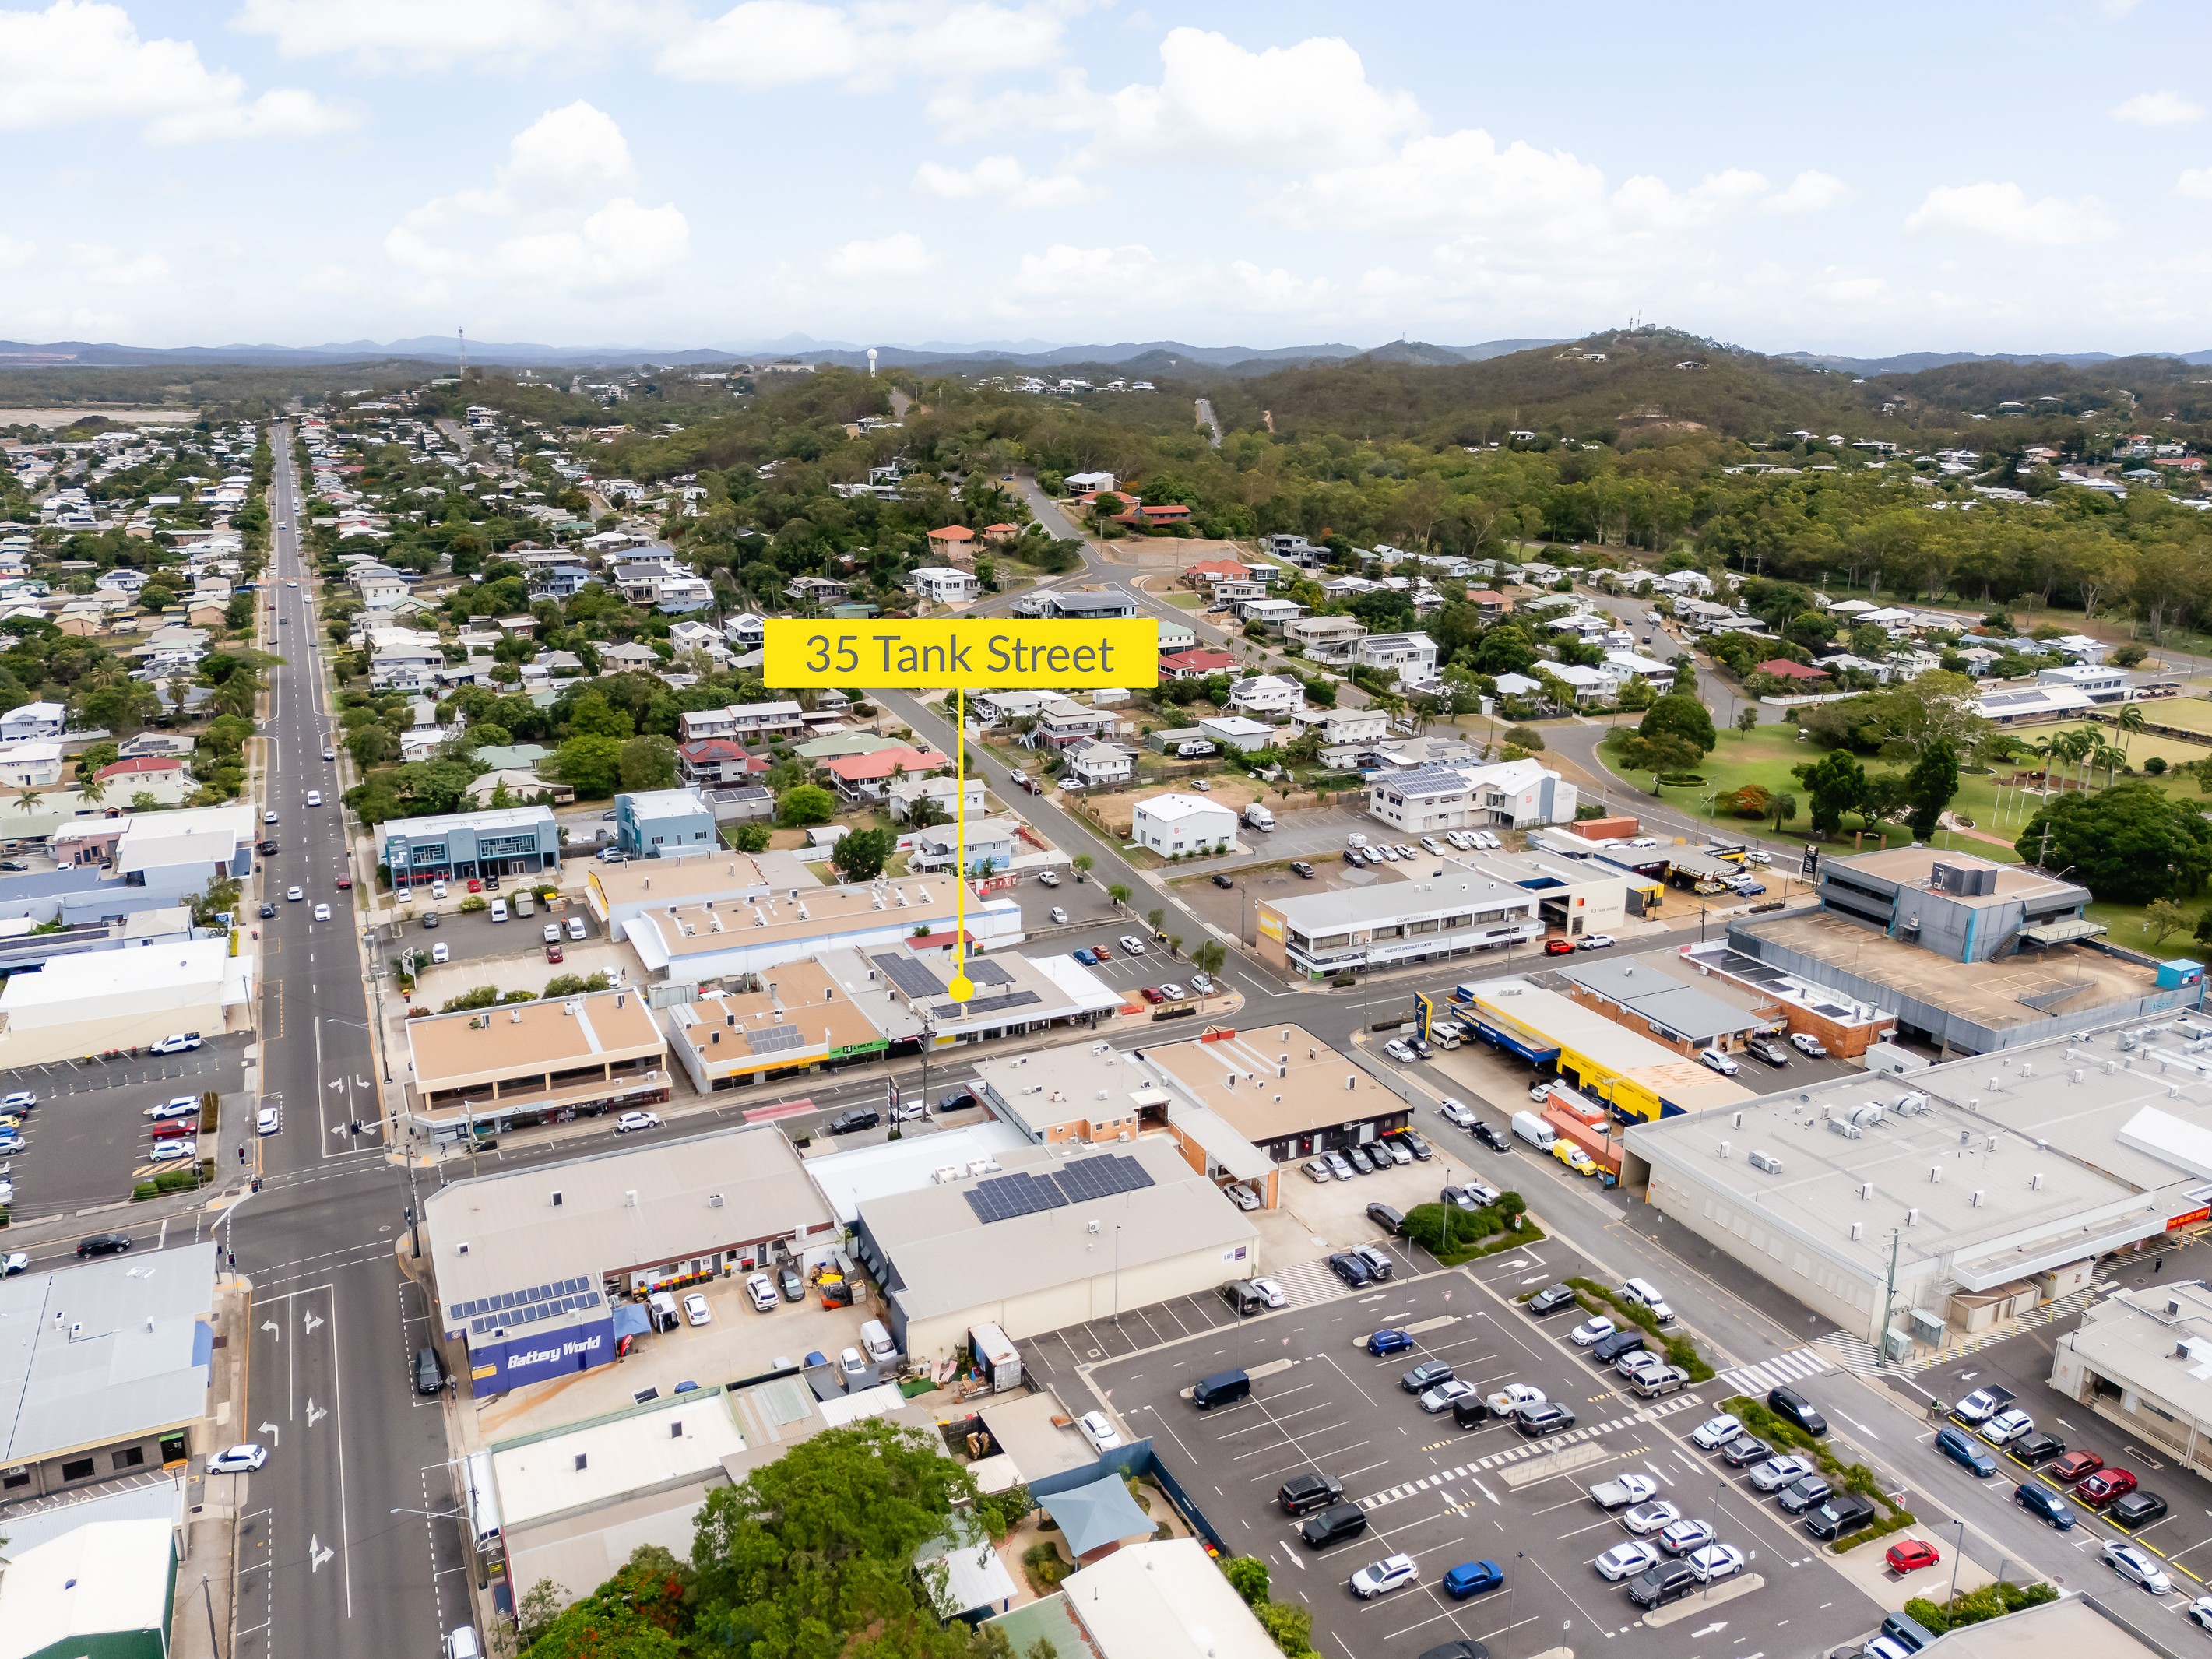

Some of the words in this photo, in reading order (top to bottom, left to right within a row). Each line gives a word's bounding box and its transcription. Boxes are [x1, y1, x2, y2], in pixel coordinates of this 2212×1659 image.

[1679, 866, 1702, 876] DUNLOP
[1454, 1011, 1479, 1027] GOODYEAR
[2178, 1214, 2195, 1223] REJECT
[508, 1348, 561, 1369] Battery
[563, 1335, 600, 1355] World
